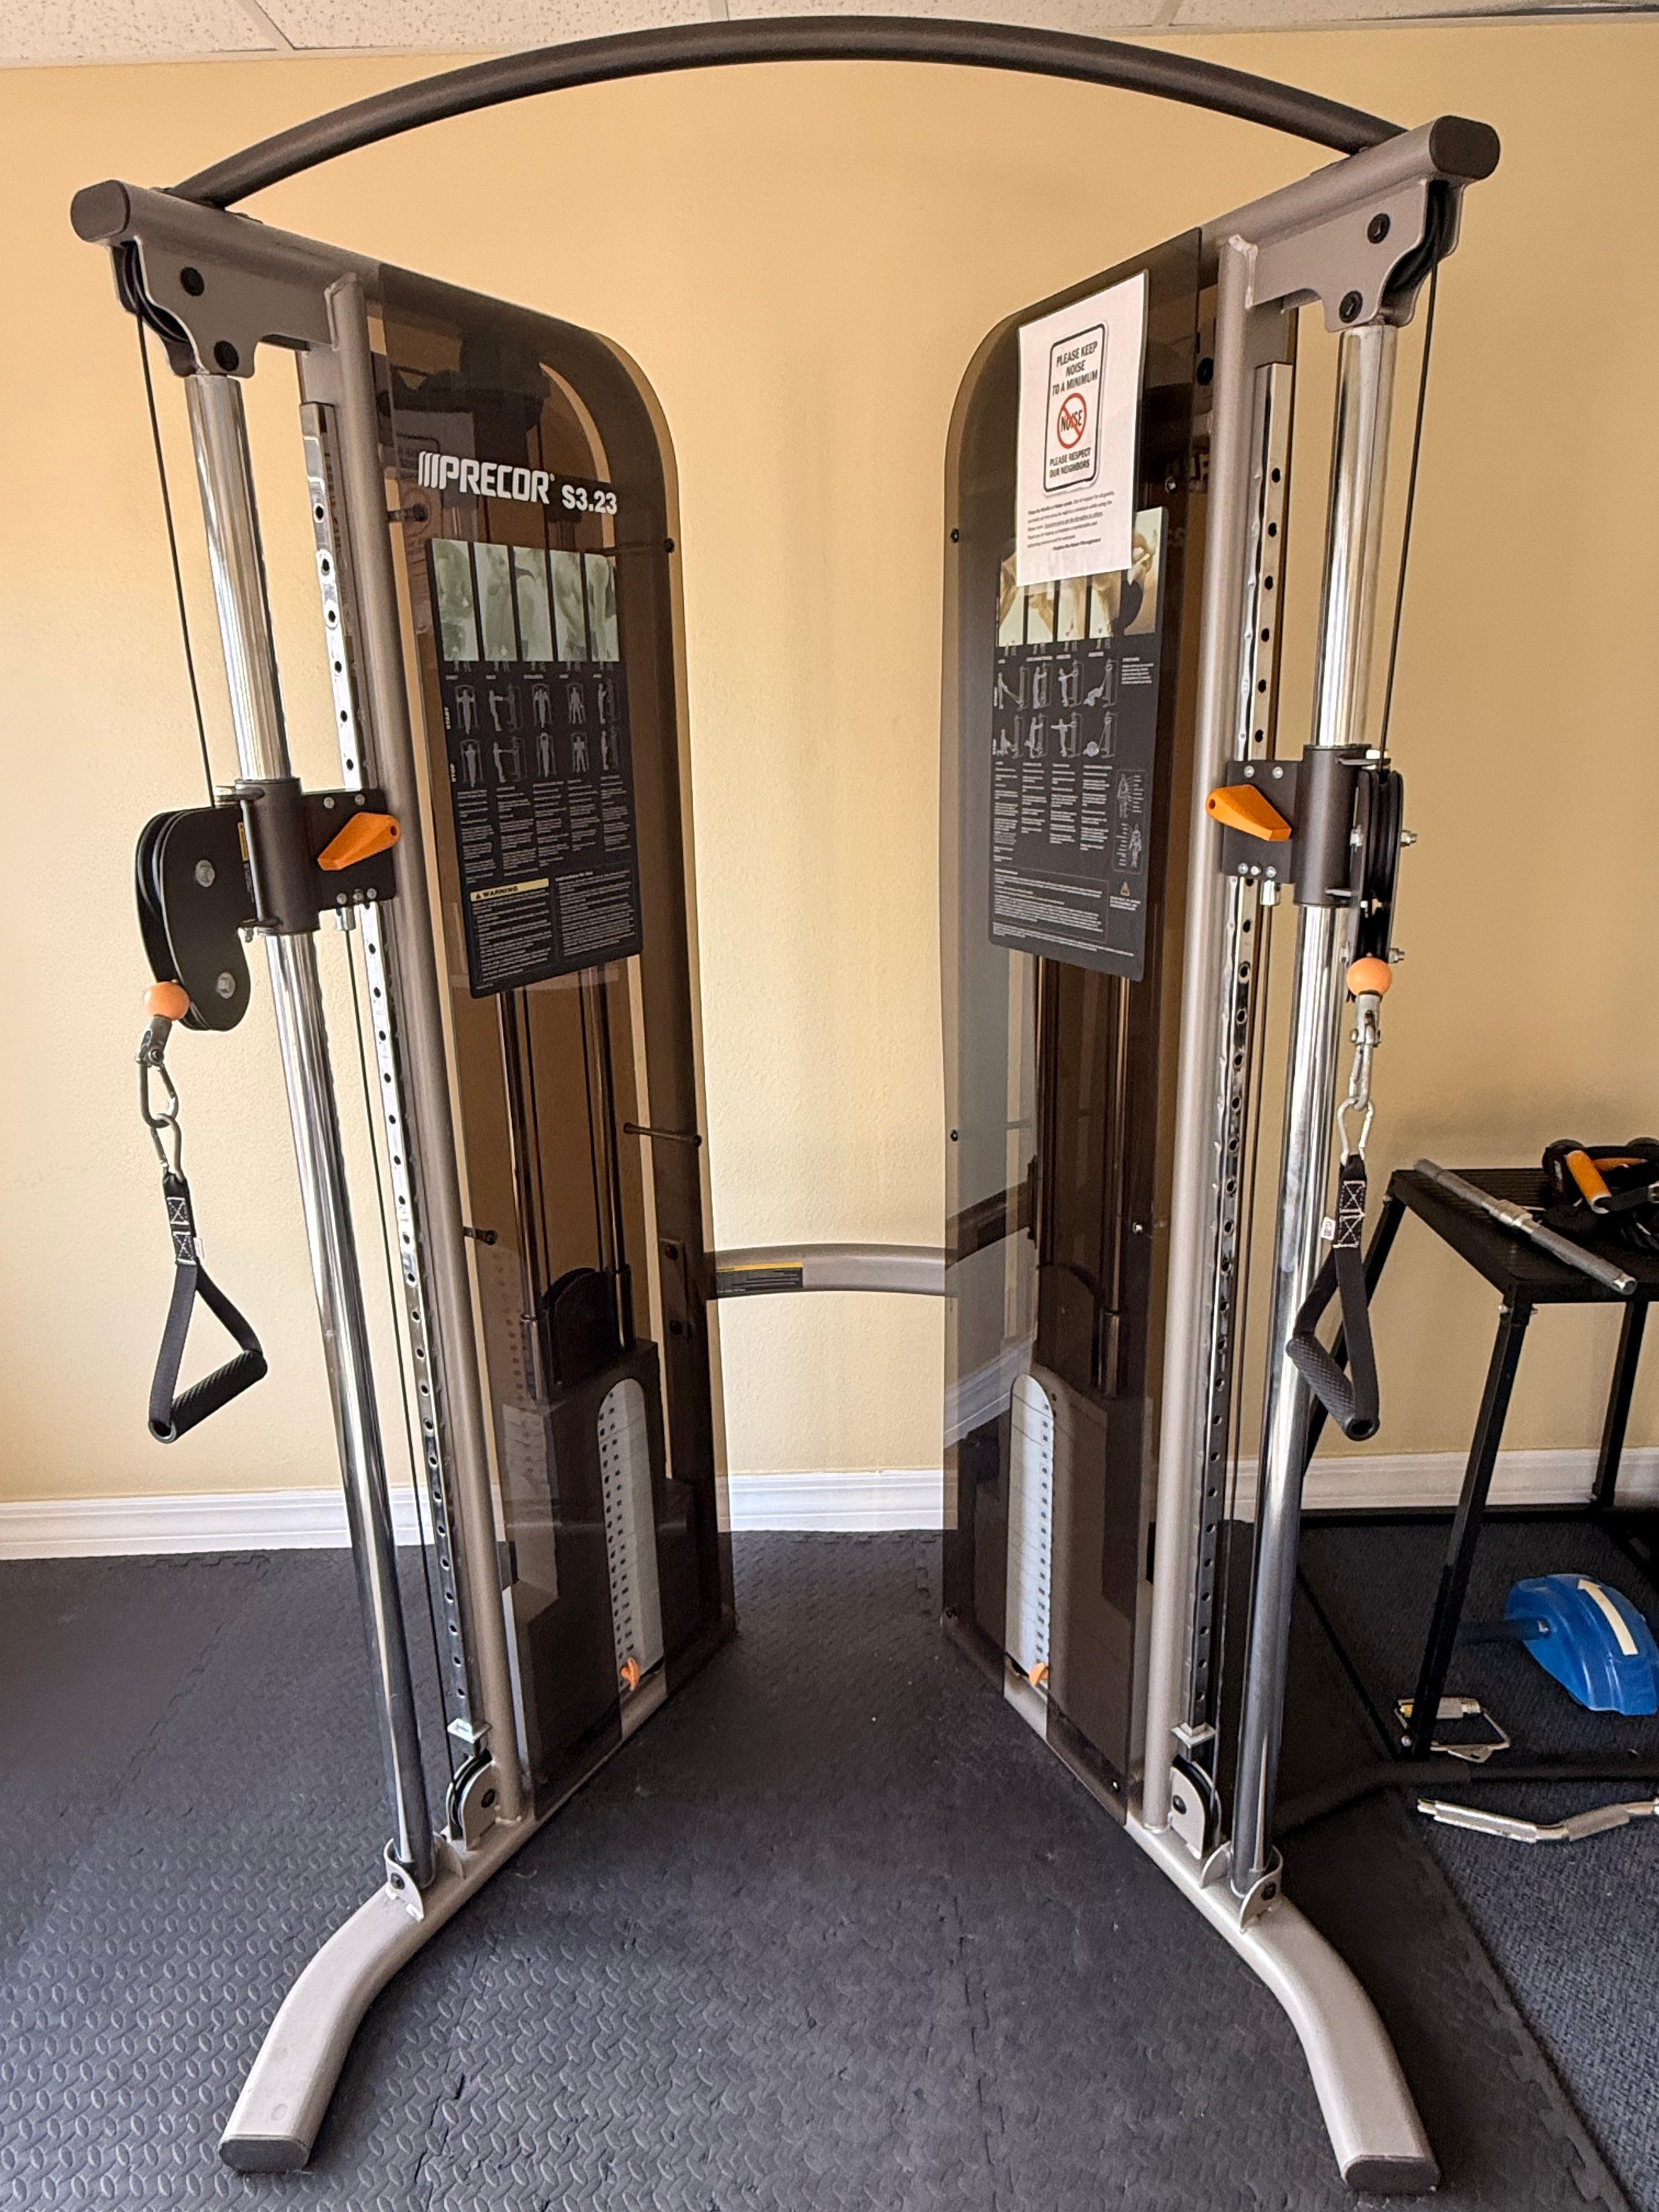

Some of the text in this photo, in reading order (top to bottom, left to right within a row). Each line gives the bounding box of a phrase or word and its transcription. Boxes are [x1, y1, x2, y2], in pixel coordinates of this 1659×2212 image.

[1056, 341, 1098, 368] PLEASE KEEP
[1066, 359, 1086, 376] NOISE
[1052, 369, 1098, 396] TO A MINIMUM
[1060, 409, 1083, 432] NOSE
[1049, 447, 1091, 466] PLEASE RESPECT
[439, 455, 618, 515] PRECOR S3.23
